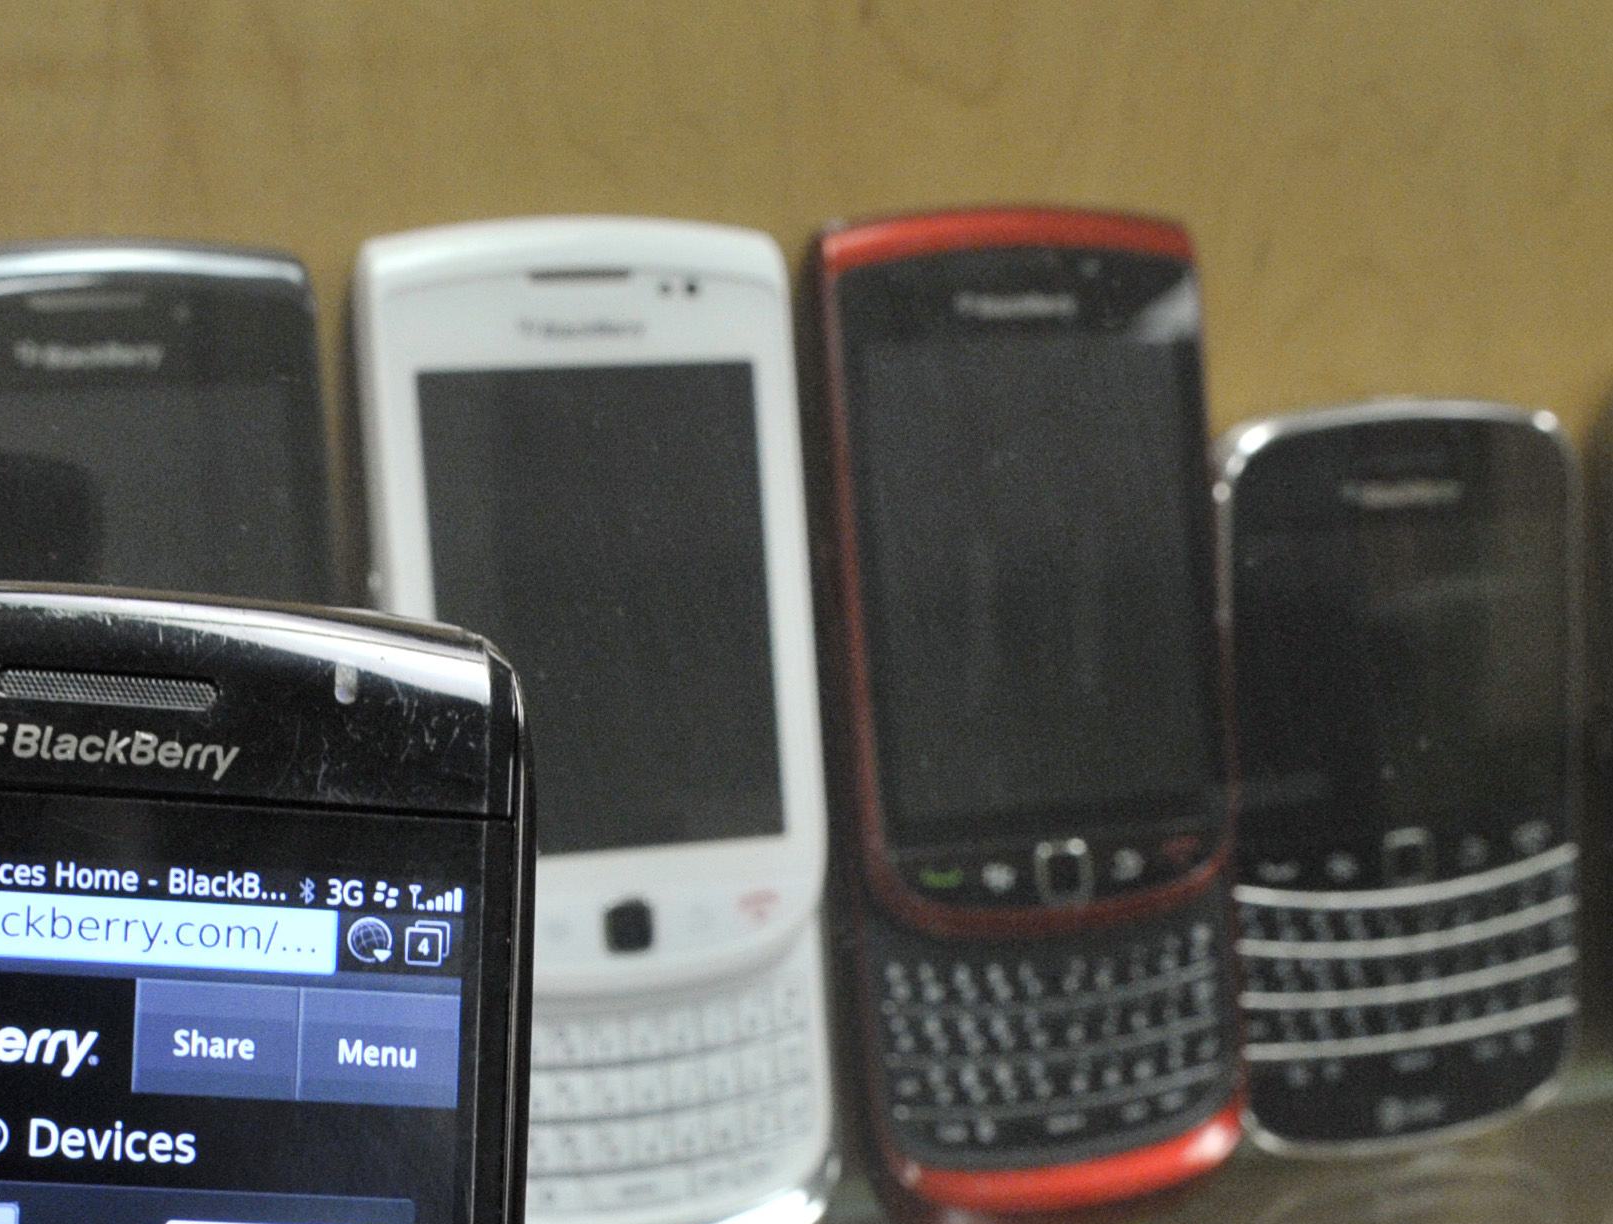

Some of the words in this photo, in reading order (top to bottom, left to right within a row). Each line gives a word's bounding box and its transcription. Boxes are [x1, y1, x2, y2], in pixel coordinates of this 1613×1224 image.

[12, 722, 240, 782] BlackBerry
[55, 860, 139, 893] Home
[168, 867, 287, 902] BlackB...
[326, 878, 364, 907] 3G
[417, 937, 430, 956] 4
[172, 1028, 255, 1061] Share
[337, 1037, 418, 1069] Menu
[27, 1117, 197, 1164] Devices
